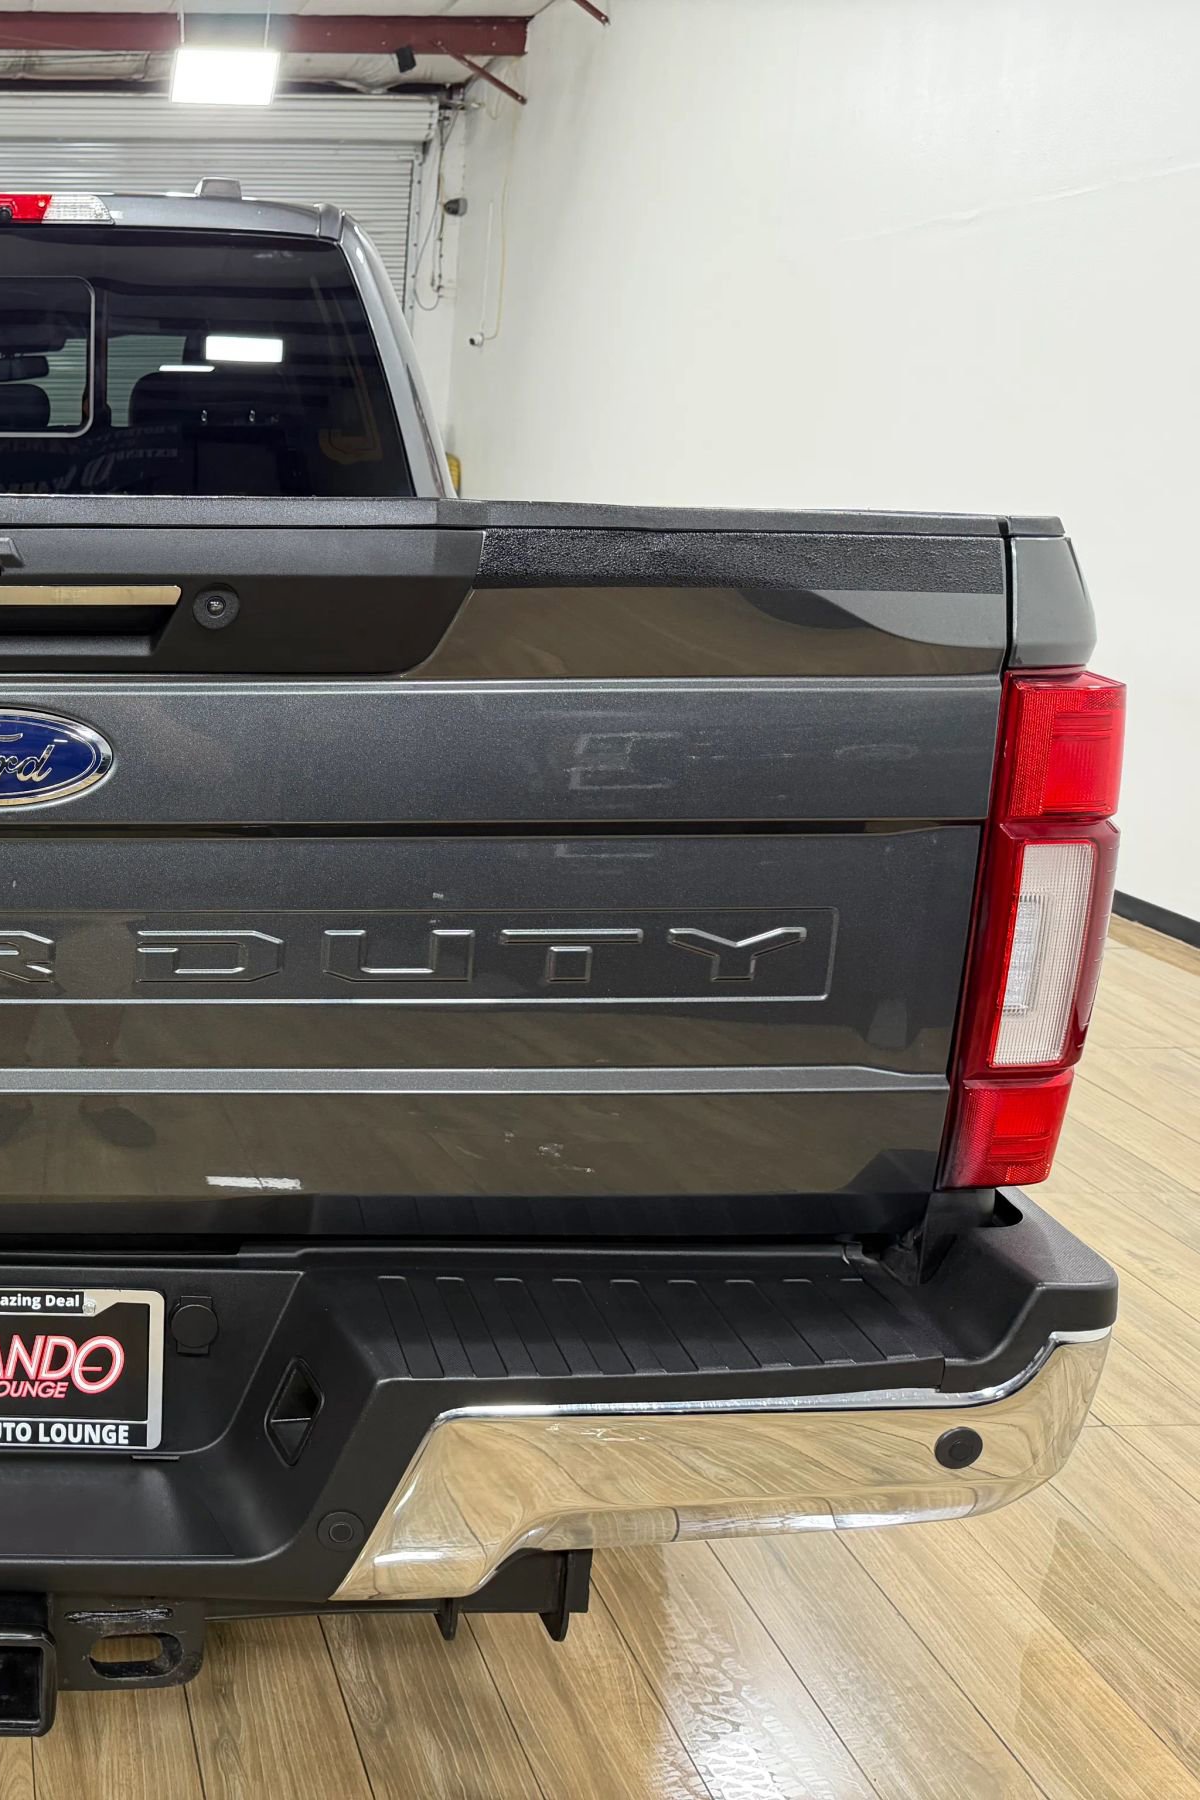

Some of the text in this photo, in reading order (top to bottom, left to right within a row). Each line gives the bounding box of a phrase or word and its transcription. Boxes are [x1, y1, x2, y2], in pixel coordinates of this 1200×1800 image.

[135, 924, 808, 984] DUTY
[45, 1293, 80, 1307] Deal
[38, 1422, 130, 1445] LOUNGE
